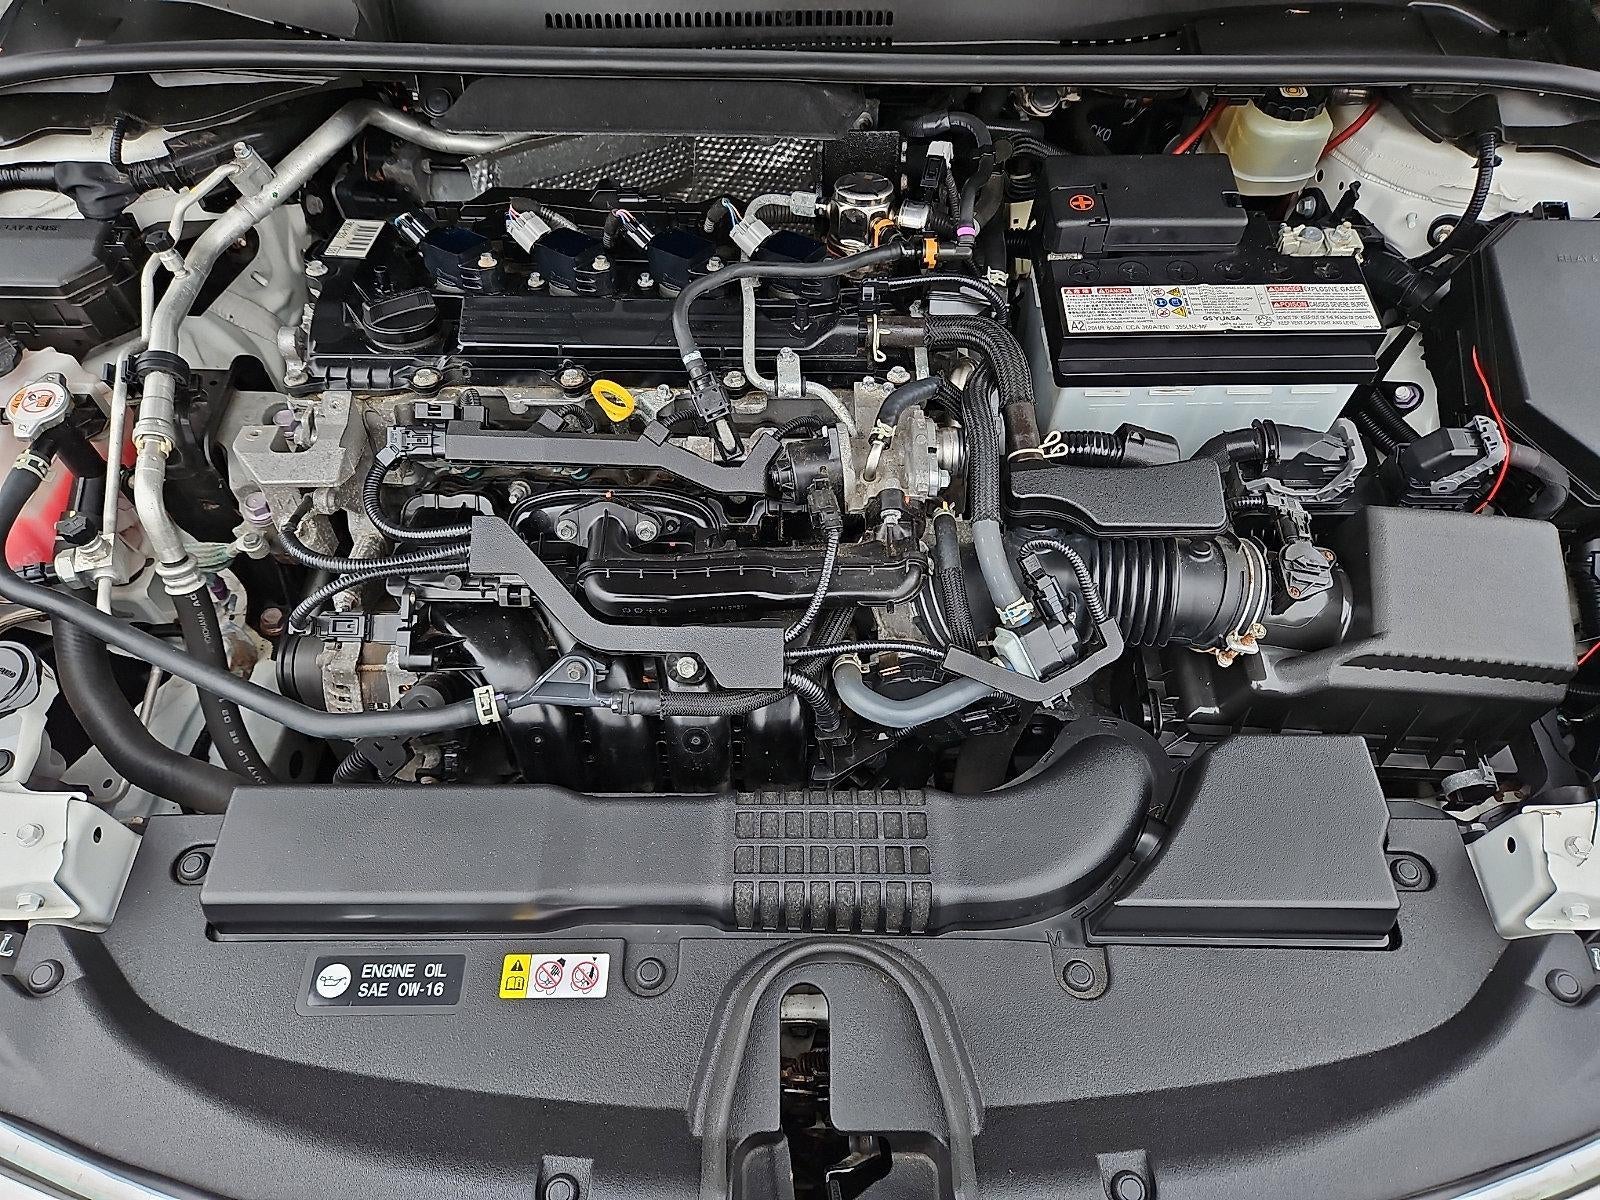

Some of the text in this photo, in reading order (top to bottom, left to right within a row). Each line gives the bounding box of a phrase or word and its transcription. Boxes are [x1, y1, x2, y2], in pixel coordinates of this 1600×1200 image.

[1072, 320, 1086, 331] A2
[361, 963, 447, 979] ENGINE OIL
[357, 981, 445, 998] SAE 0W-16
